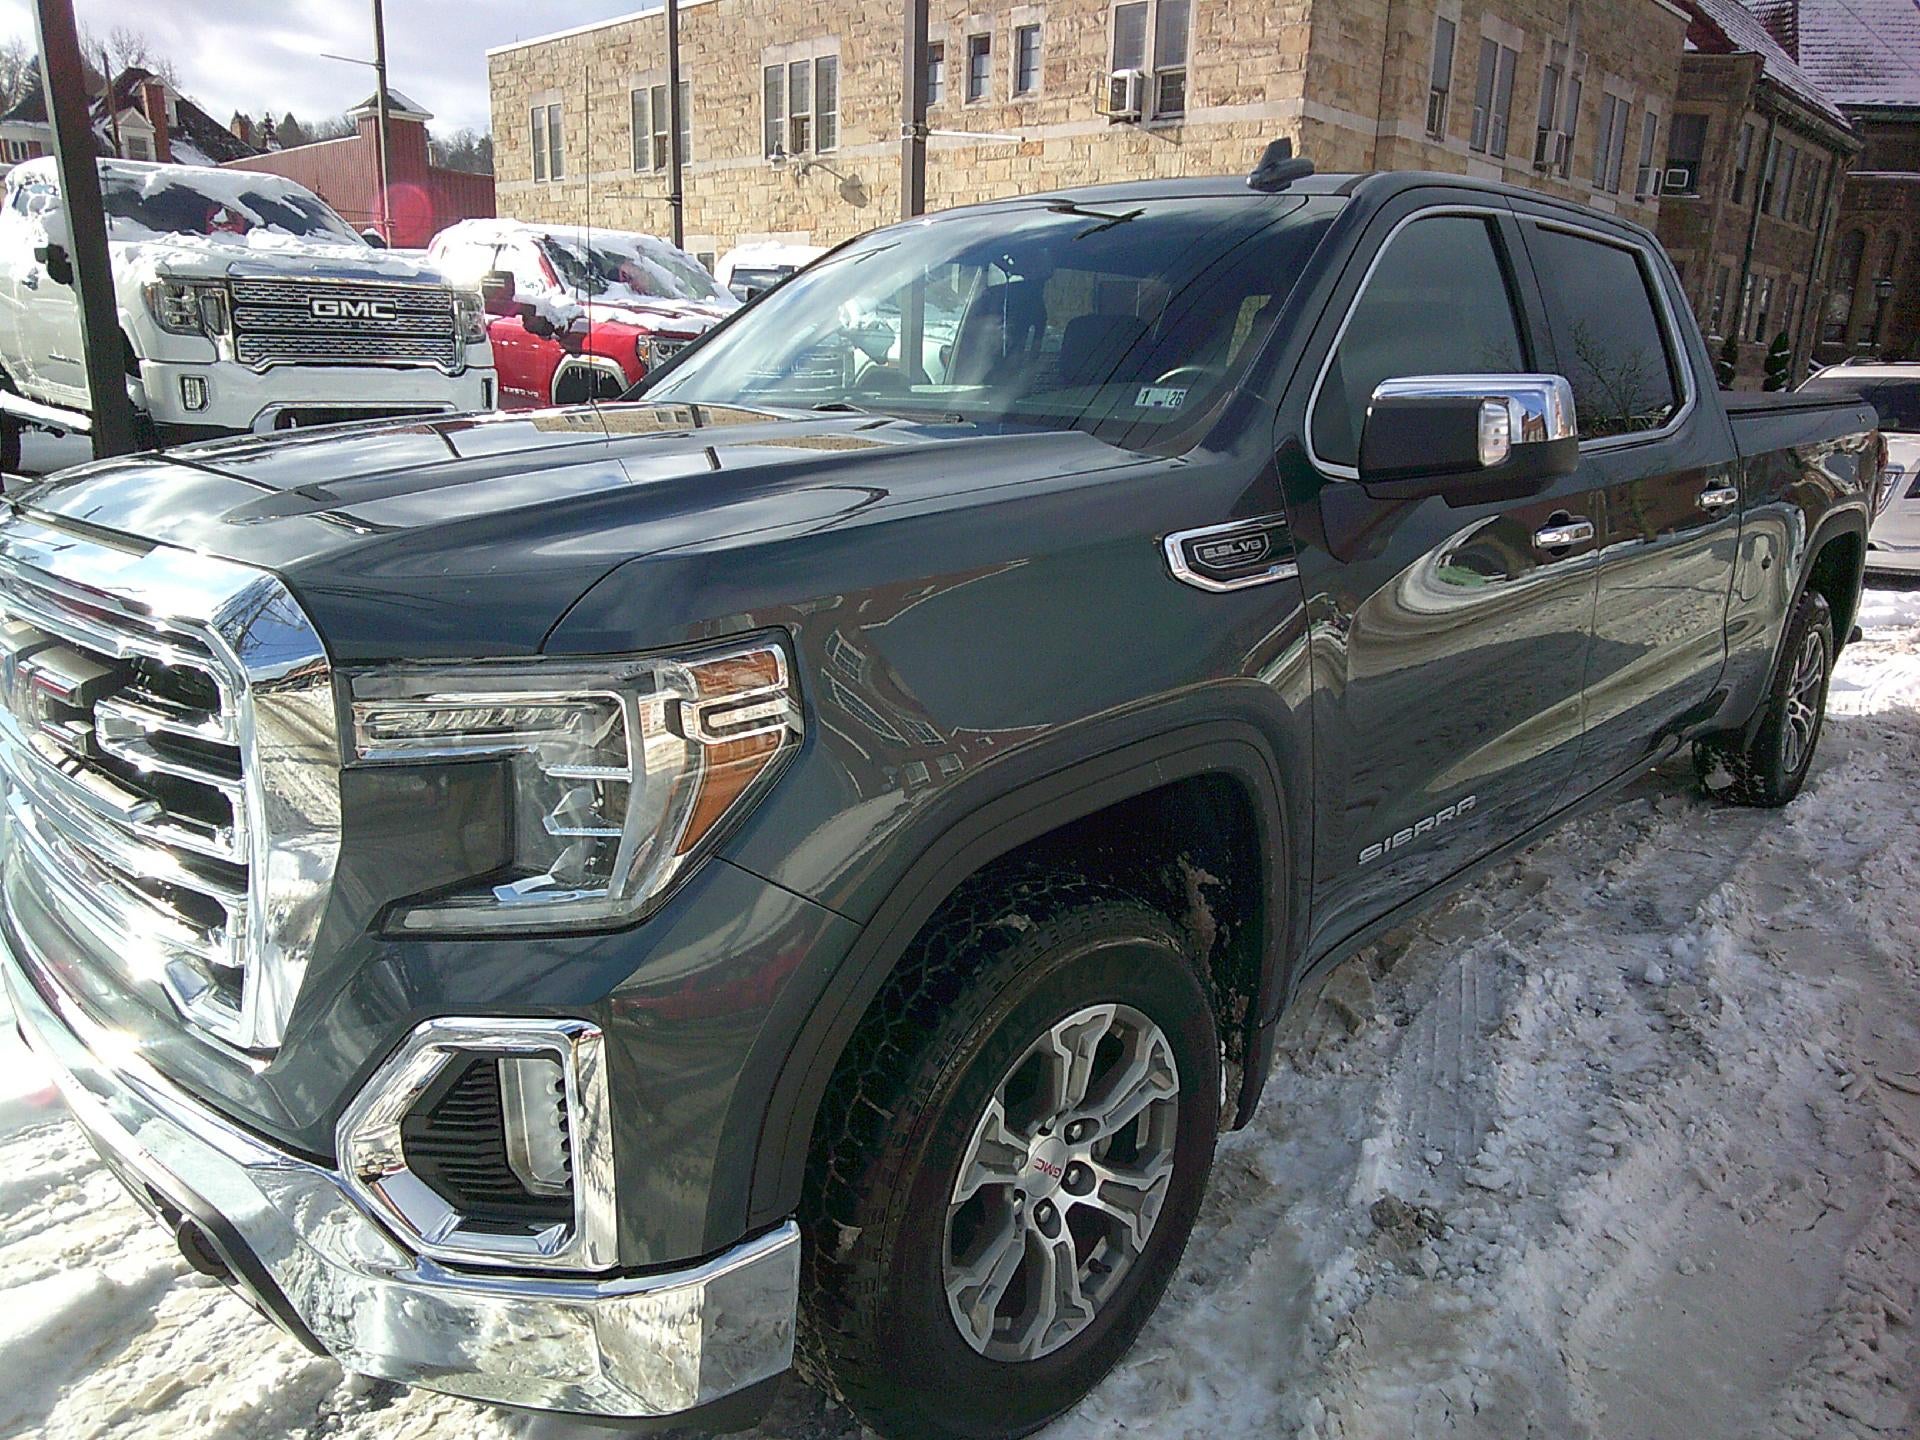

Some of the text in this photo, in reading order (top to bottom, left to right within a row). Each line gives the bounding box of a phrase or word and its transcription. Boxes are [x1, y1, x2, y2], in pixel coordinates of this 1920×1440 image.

[311, 300, 396, 319] GMC
[1141, 389, 1151, 405] 1
[1358, 795, 1476, 865] SIERRA
[1033, 1157, 1062, 1179] GMC
